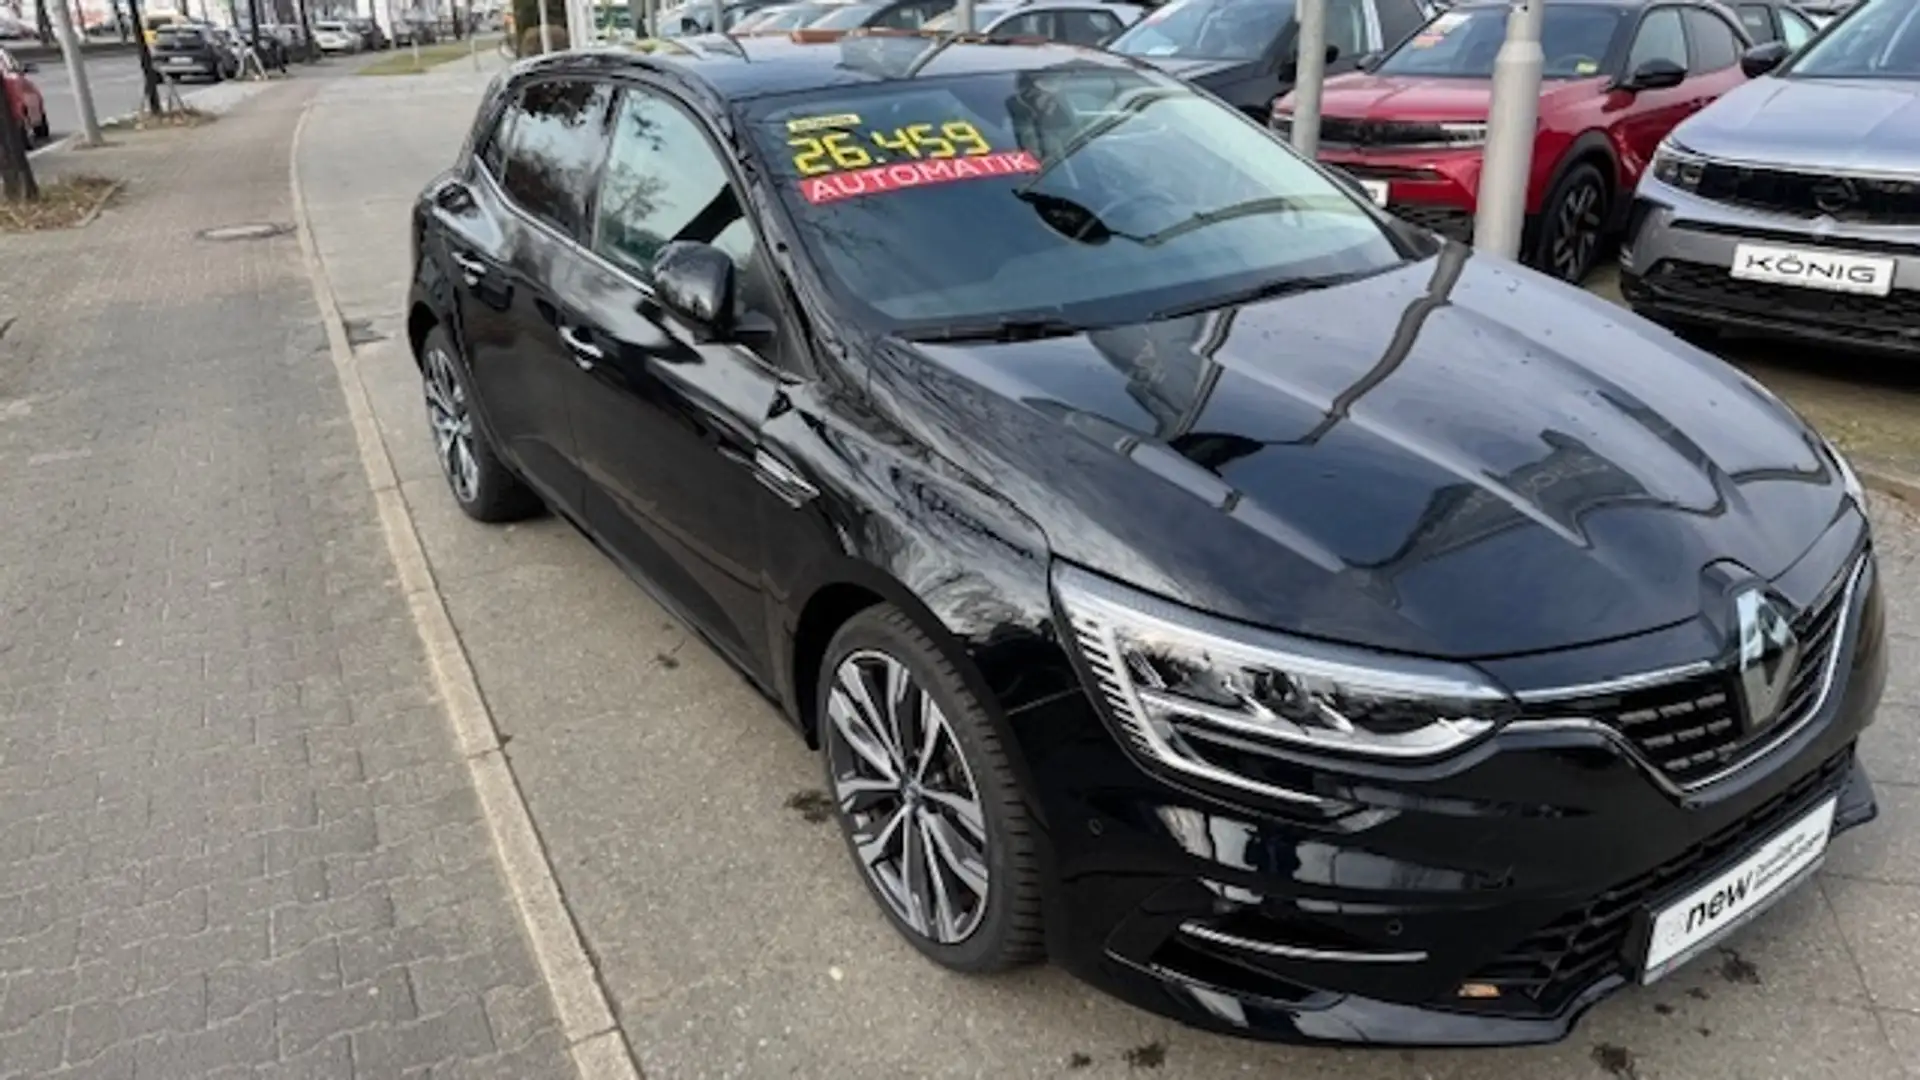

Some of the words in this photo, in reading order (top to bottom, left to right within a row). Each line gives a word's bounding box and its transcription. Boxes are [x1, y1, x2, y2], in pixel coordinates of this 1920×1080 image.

[787, 121, 991, 174] 26.459
[811, 153, 1034, 200] AUTOMATIK
[1746, 253, 1876, 283] KÖNIG
[1686, 871, 1753, 933] new
